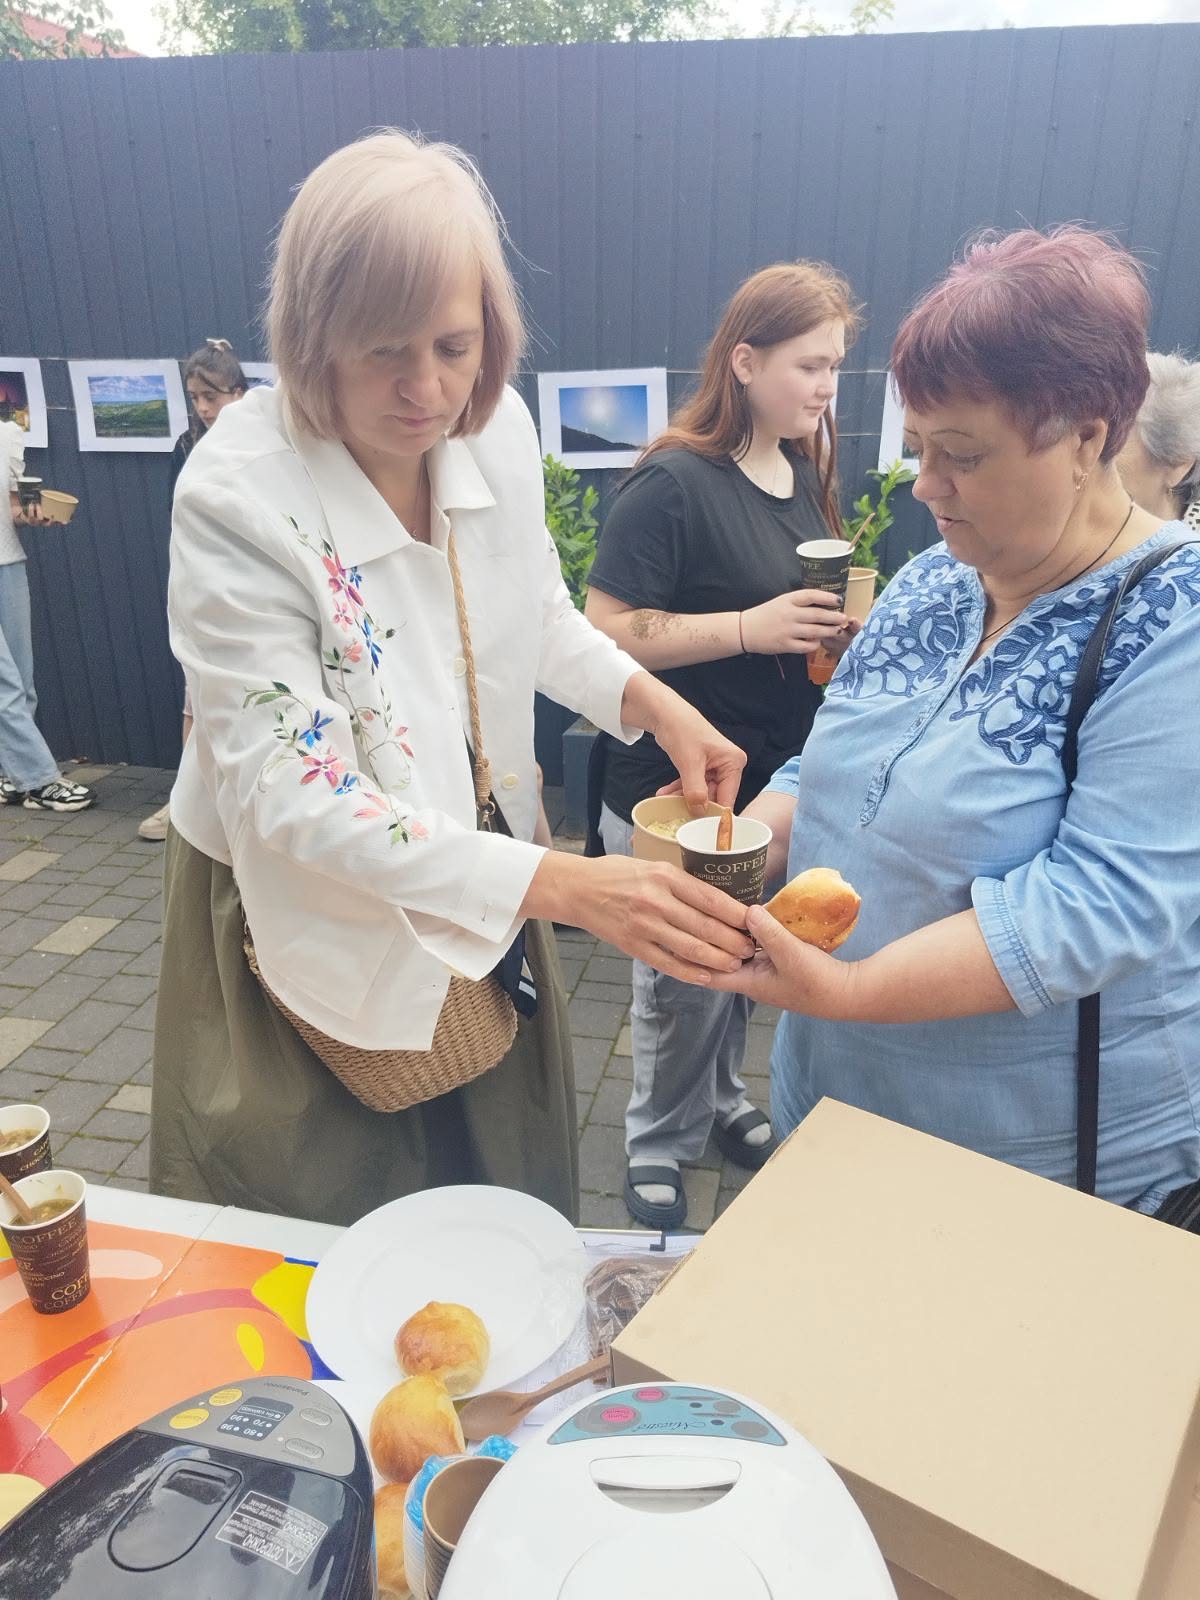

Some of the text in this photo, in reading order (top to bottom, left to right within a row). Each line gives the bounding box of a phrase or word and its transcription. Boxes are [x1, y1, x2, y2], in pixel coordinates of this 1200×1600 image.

[704, 853, 766, 874] COFFEE
[11, 1217, 78, 1245] COFFEE
[252, 1418, 266, 1427] 70
[242, 1534, 284, 1561] ОСТОРОЖНО
